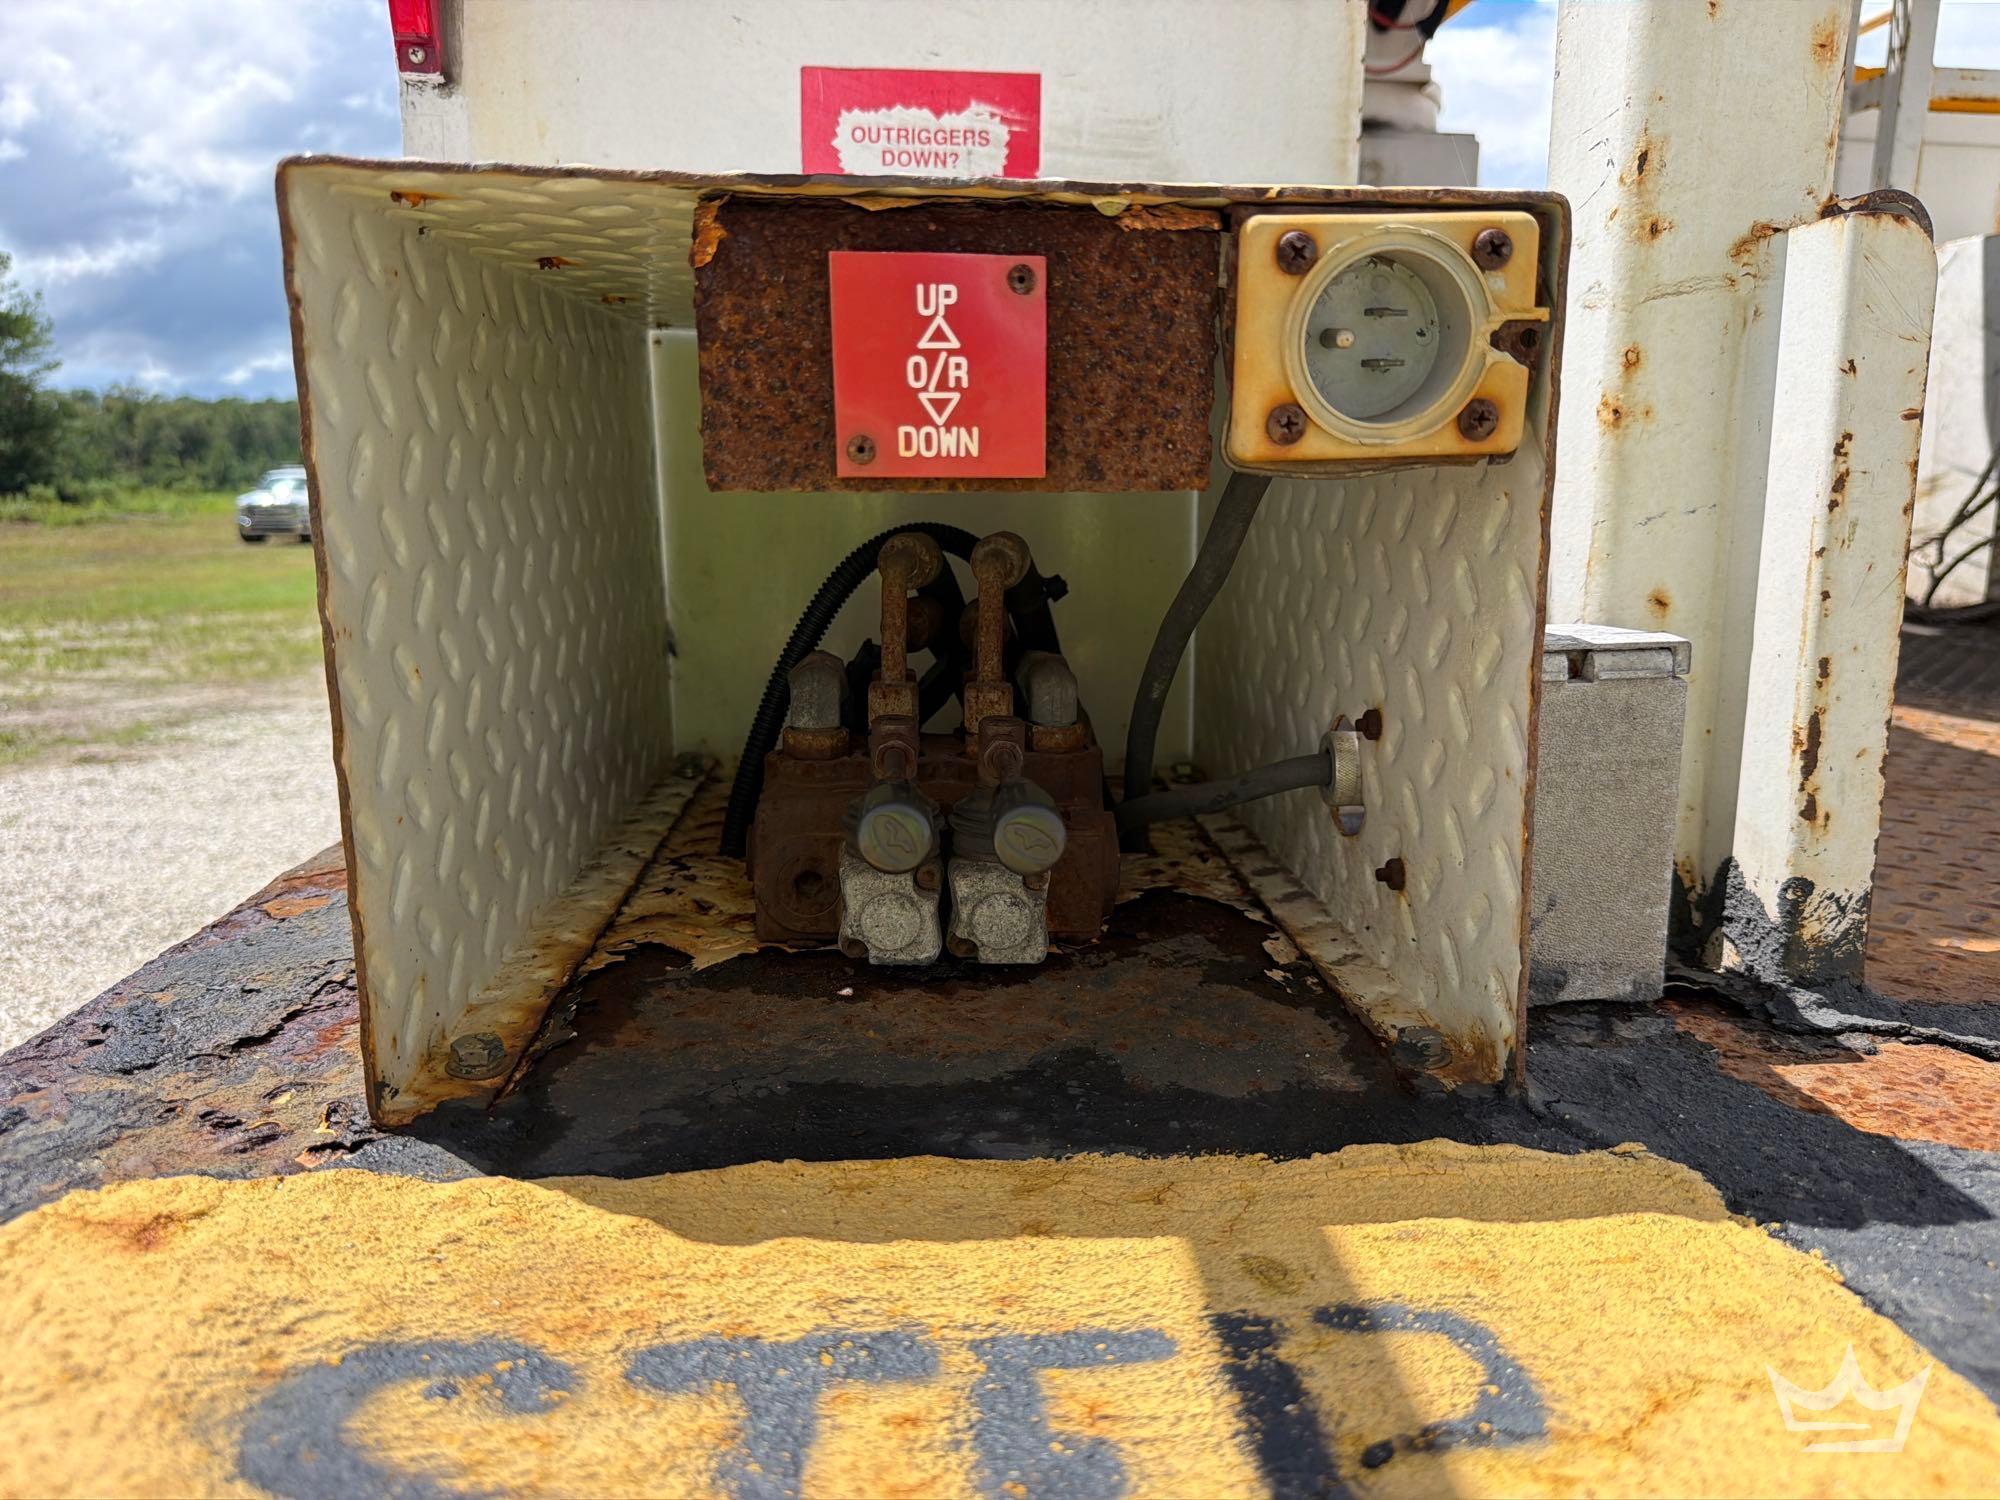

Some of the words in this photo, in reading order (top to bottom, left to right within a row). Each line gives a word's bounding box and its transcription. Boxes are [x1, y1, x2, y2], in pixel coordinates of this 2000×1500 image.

[851, 126, 991, 147] OUTRIGGERS
[881, 149, 959, 169] DOWN?
[916, 284, 958, 316] UP
[906, 351, 969, 391] O/R
[898, 425, 979, 458] DOWN
